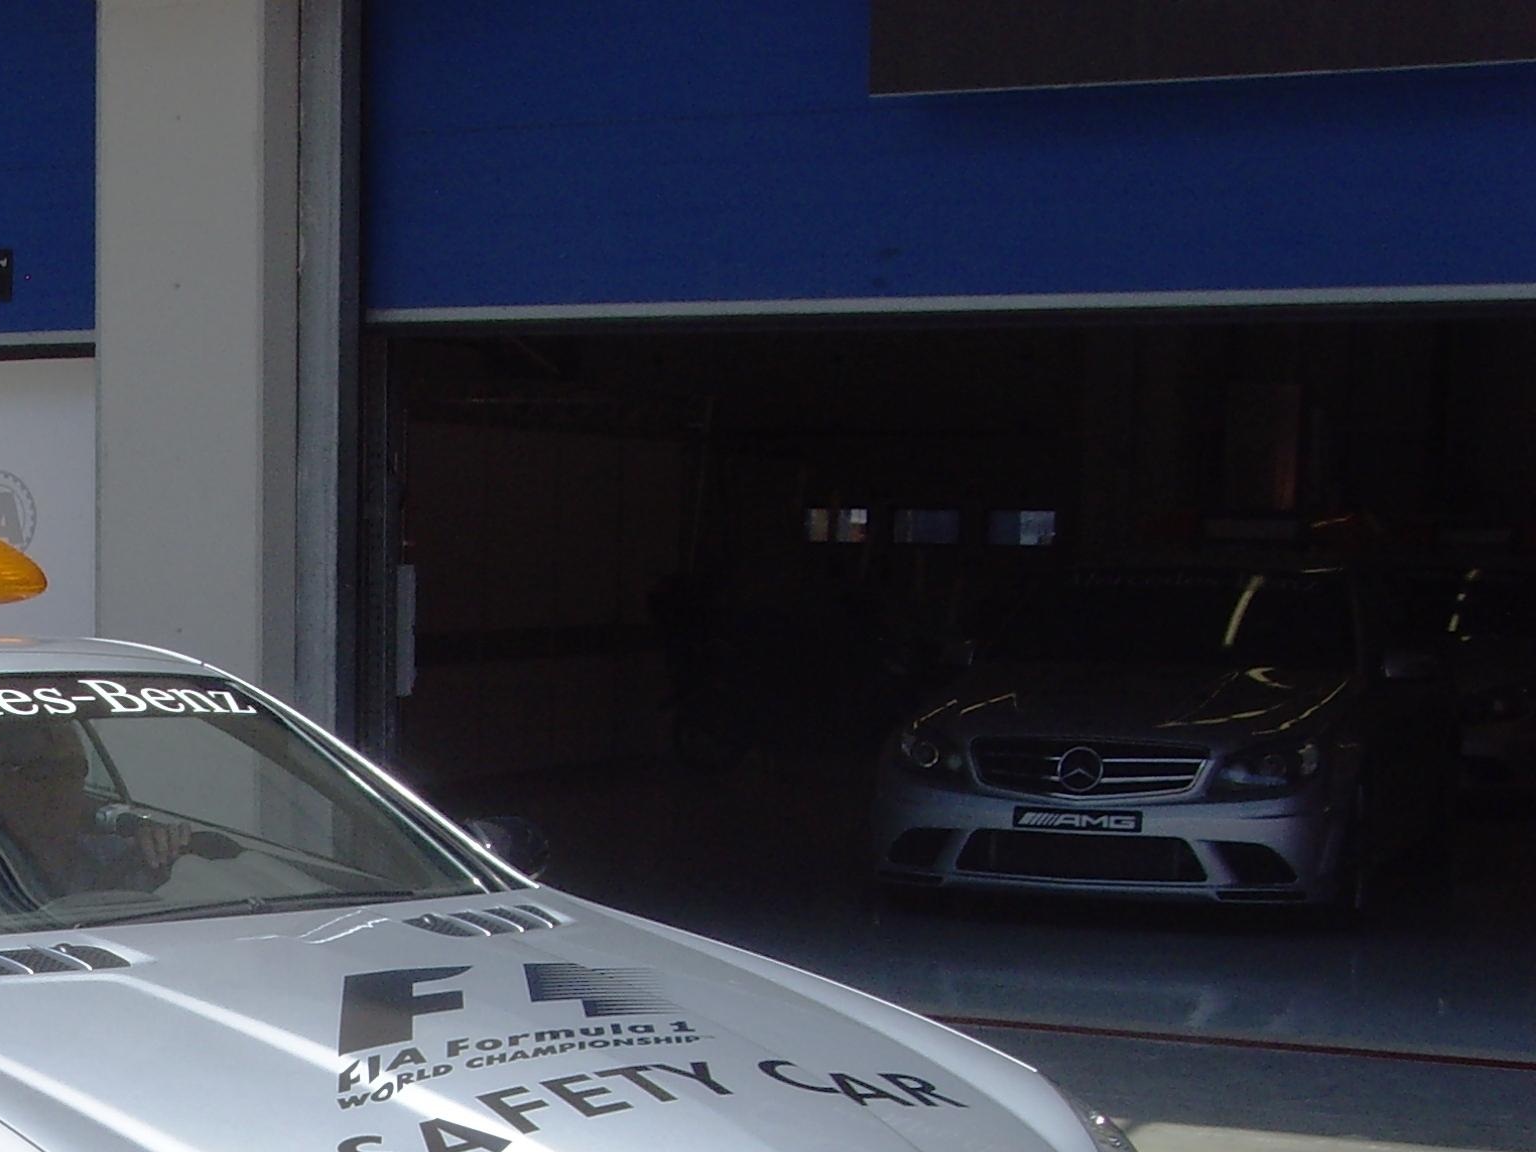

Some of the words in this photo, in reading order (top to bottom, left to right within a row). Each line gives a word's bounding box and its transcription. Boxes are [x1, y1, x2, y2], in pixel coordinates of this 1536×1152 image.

[1054, 813, 1136, 830] AMG
[337, 1047, 428, 1094] FIA
[447, 1022, 656, 1058] Formula
[669, 1021, 696, 1033] 1
[337, 1063, 454, 1110] WORLD
[465, 1035, 701, 1069] CHAMPIONSHIP
[758, 1059, 970, 1108] CAR
